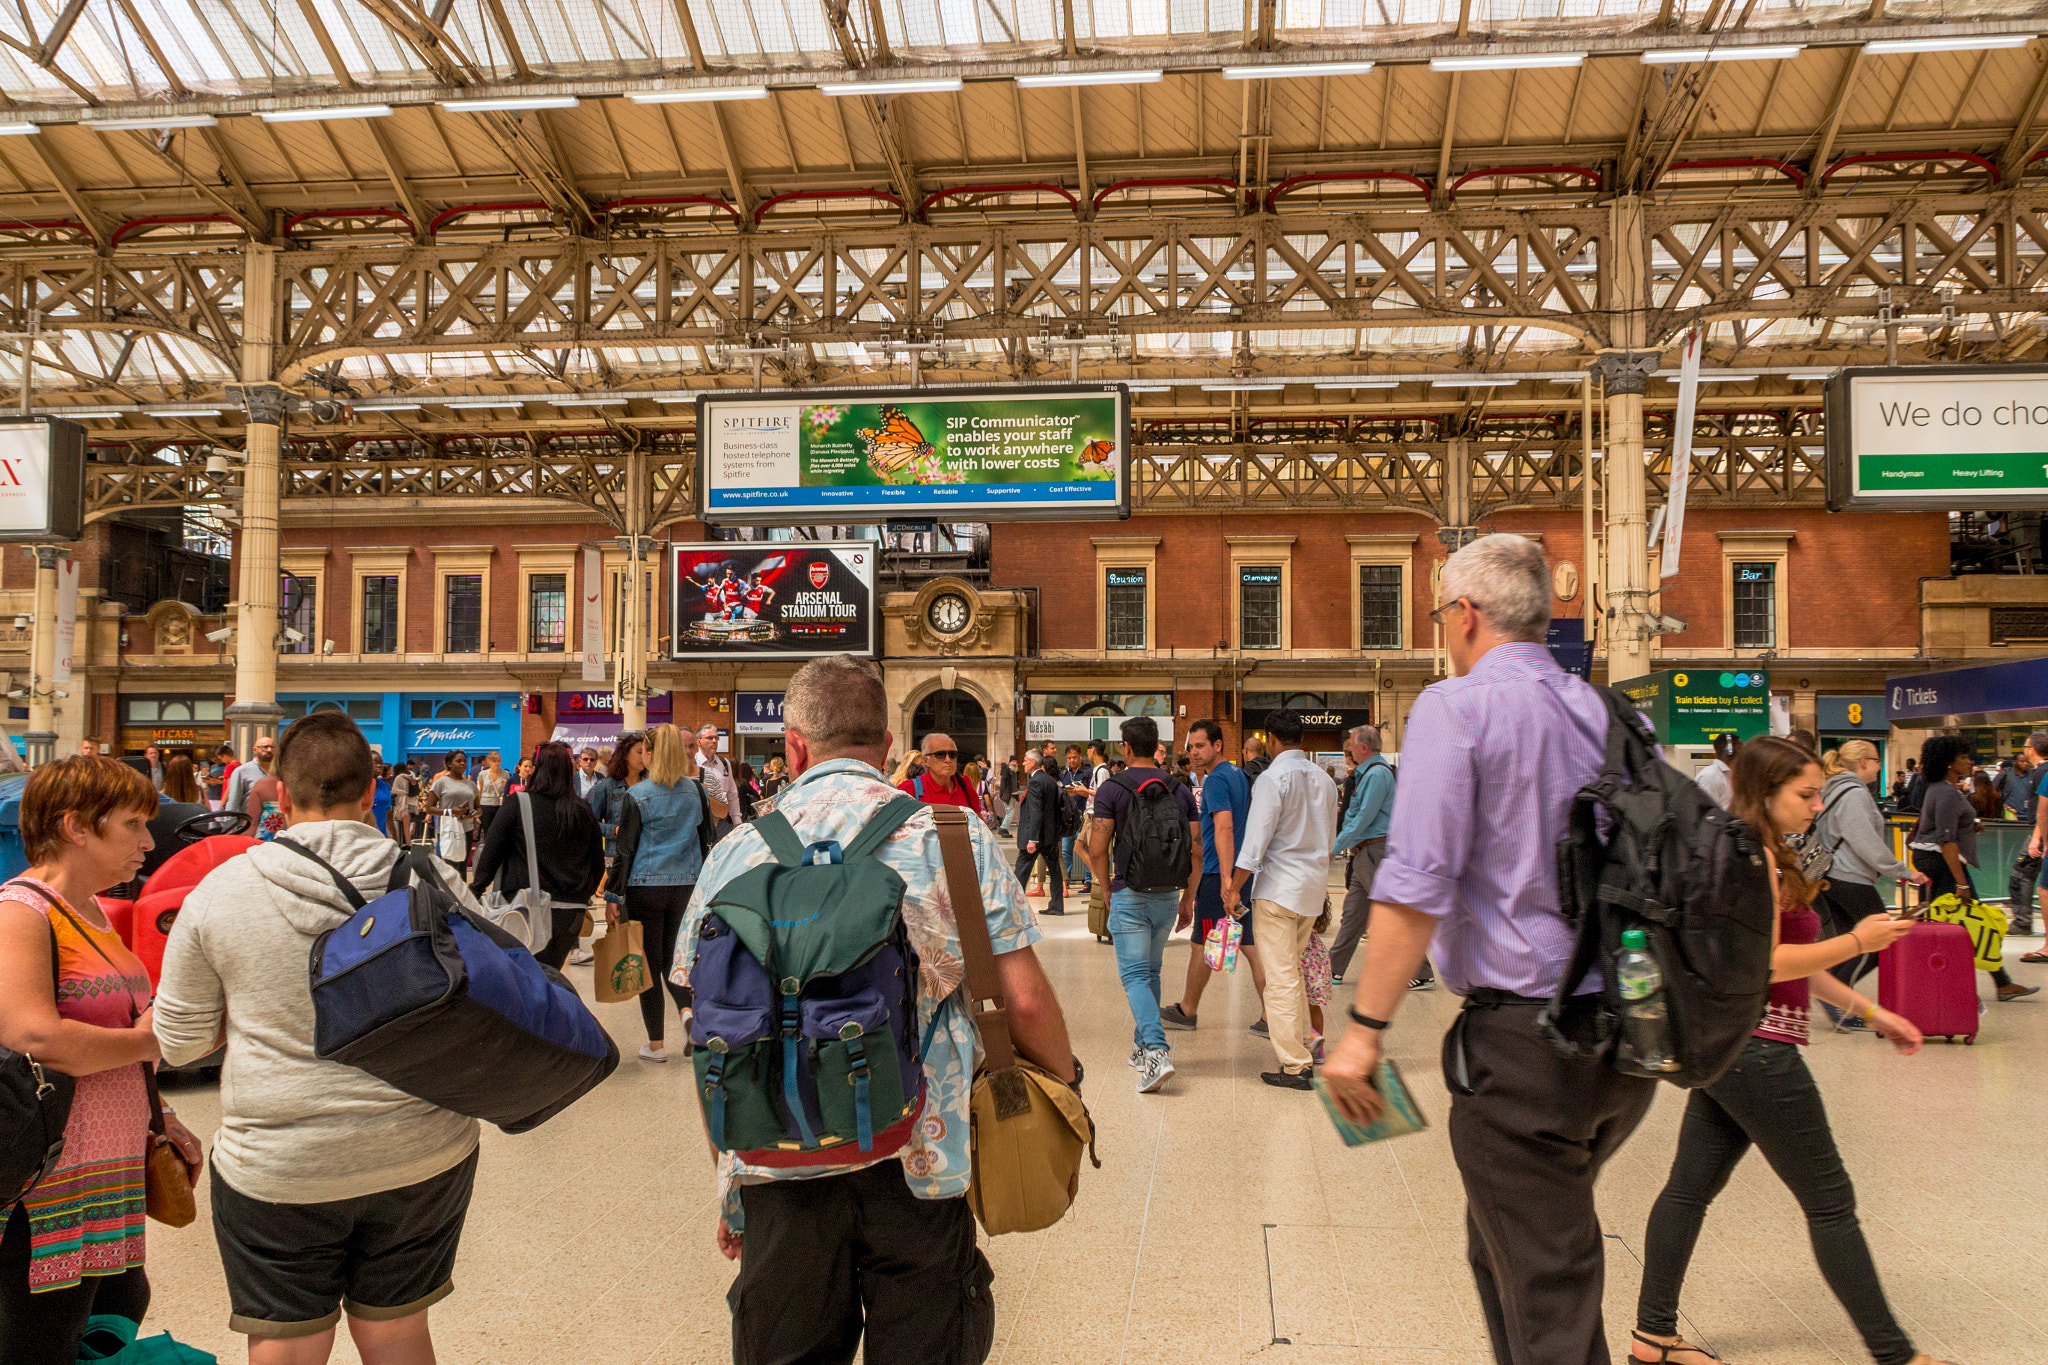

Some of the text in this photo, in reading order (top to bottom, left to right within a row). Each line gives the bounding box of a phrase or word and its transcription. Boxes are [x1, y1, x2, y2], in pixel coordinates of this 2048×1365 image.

[1879, 399, 2048, 427] We do cho
[723, 416, 790, 428] SPITFIRE
[946, 417, 968, 429] SIP
[946, 428, 1072, 444] enables your staff
[723, 442, 778, 450] Business-class
[946, 443, 1074, 458] to work anywhere
[723, 451, 791, 460] hosted telephone
[723, 460, 775, 469] systems from
[946, 457, 1060, 470] with lower costs
[723, 470, 751, 479] Spitfire
[1881, 470, 1925, 478] Handyman
[1952, 469, 2004, 478] Heavy Lifting
[723, 490, 789, 499] www.spitfire.co.uk
[986, 487, 1021, 495] Supportive
[1109, 573, 1144, 584] Reunion
[1242, 574, 1278, 582] Champagne
[1741, 568, 1762, 581] Bar
[795, 591, 843, 605] ARSENAL
[781, 604, 857, 618] STADIUM TOUR
[1675, 695, 1763, 706] Train tickets buy & collect
[1906, 688, 1938, 706] Tickets
[1300, 711, 1342, 726] ssorize
[152, 729, 195, 738] MI CASA
[414, 727, 476, 747] Paperchase
[554, 735, 575, 743] Free
